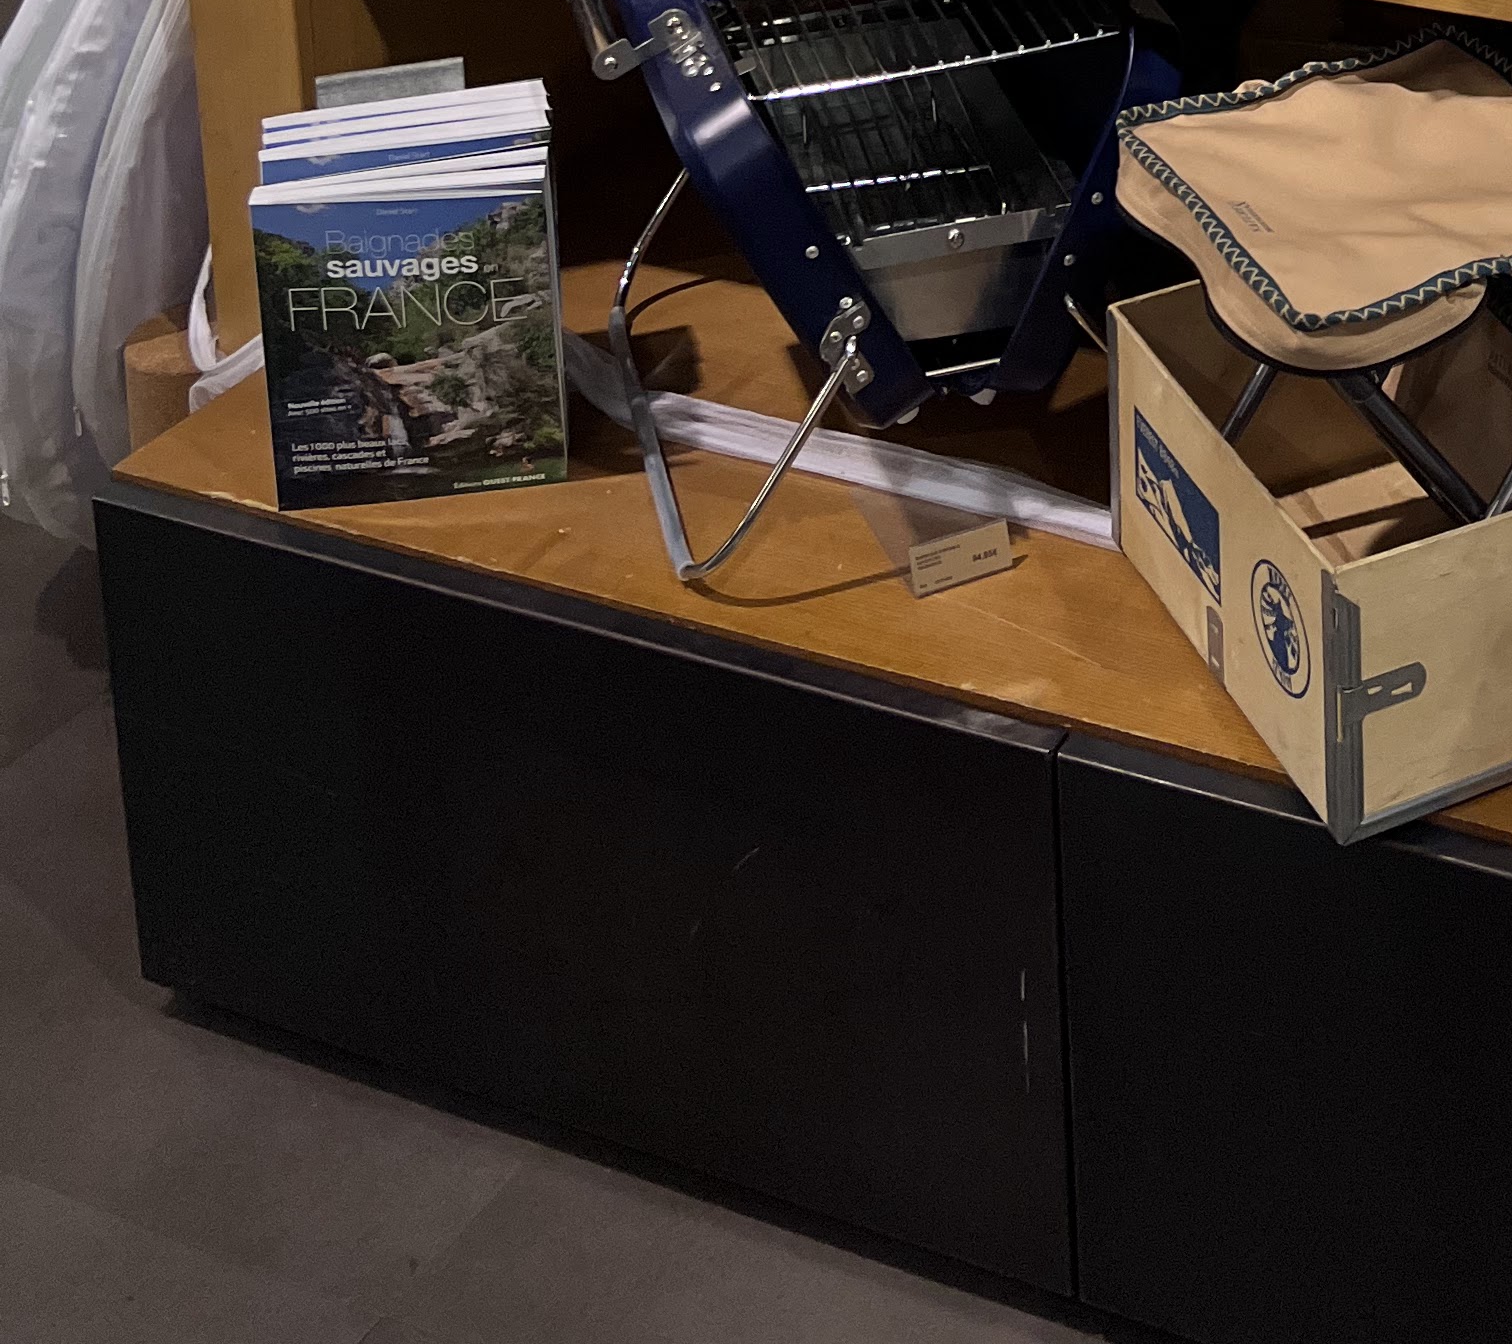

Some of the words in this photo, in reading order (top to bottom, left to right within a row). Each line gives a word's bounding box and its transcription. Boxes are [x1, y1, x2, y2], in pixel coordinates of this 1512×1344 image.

[324, 230, 475, 262] Baignades
[326, 253, 480, 282] sauvages
[483, 263, 499, 274] en
[287, 277, 528, 333] FRANCE
[287, 400, 320, 410] Nouvelle
[291, 442, 309, 452] Les
[310, 441, 335, 452] 1000
[336, 440, 356, 454] plus
[358, 438, 386, 449] beaux
[332, 449, 375, 461] cascades
[376, 448, 387, 459] et
[294, 463, 332, 476] piscines
[335, 460, 383, 471] naturelles
[384, 458, 396, 469] de
[397, 455, 430, 467] France
[483, 477, 511, 487] OUEST
[512, 473, 546, 483] FRANCE
